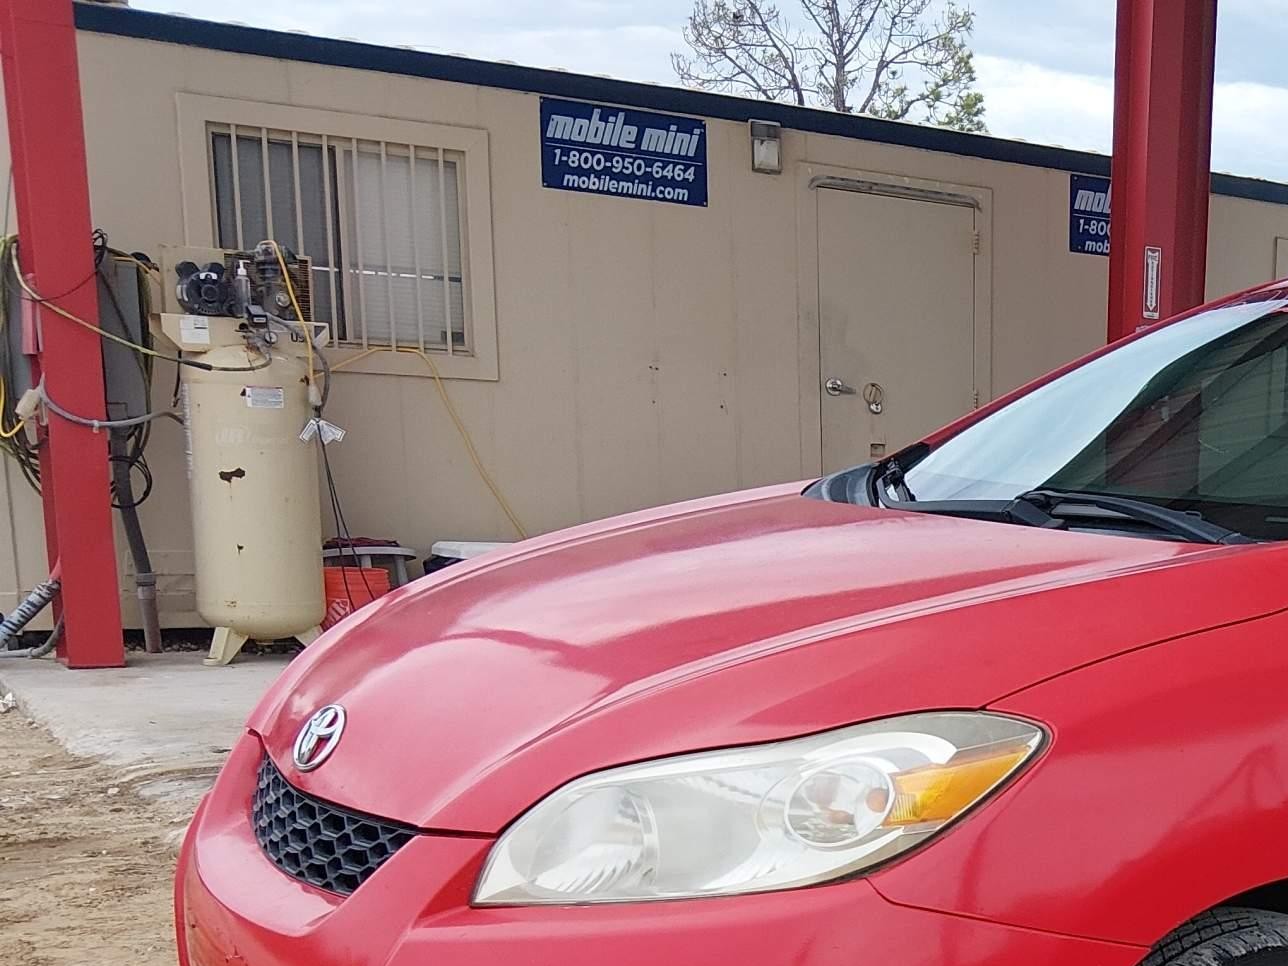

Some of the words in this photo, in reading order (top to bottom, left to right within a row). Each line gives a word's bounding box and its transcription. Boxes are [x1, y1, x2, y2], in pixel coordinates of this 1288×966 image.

[546, 108, 638, 149] mobile
[641, 124, 701, 157] mini
[553, 148, 695, 183] 1-800-950-6464
[562, 173, 689, 201] mobilemini.com
